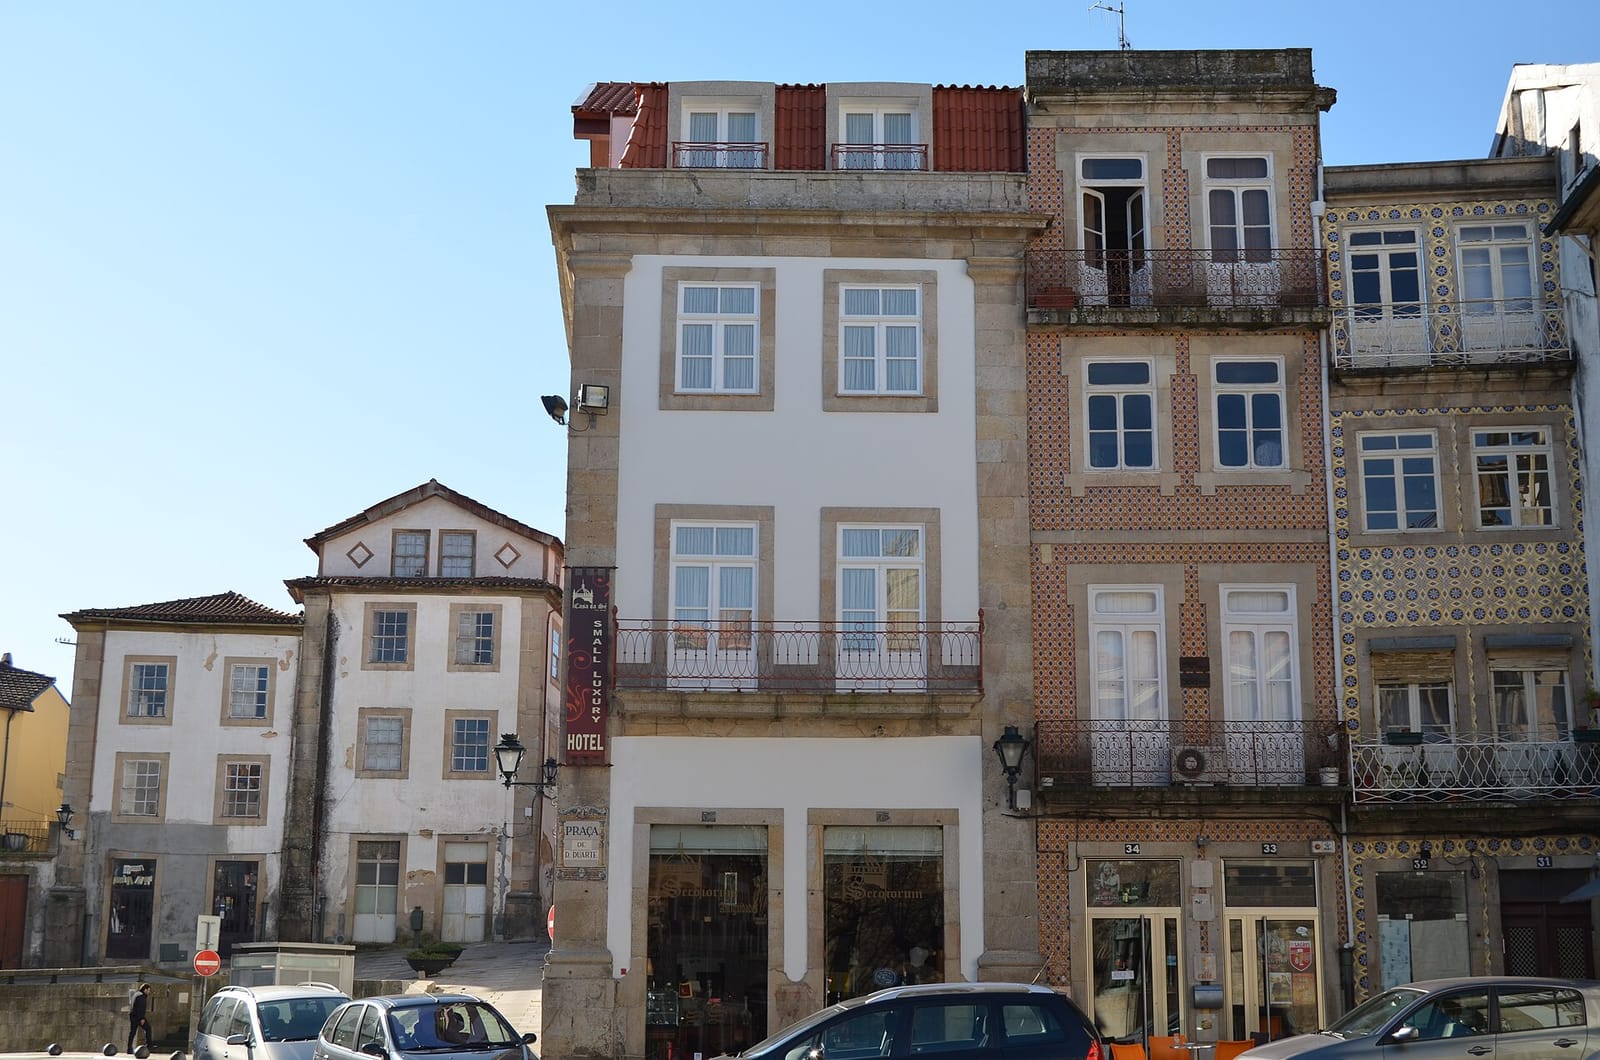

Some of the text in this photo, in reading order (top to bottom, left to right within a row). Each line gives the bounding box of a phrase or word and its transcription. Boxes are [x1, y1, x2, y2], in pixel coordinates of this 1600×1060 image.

[592, 620, 603, 664] SMALL
[591, 671, 602, 724] LUXURY
[567, 733, 604, 751] HOTEL
[566, 826, 599, 838] PRAÇA
[1125, 844, 1140, 854] 34
[1263, 844, 1277, 854] 33
[572, 851, 598, 859] DUARTE
[1414, 859, 1428, 869] 32
[1537, 856, 1551, 867] 31
